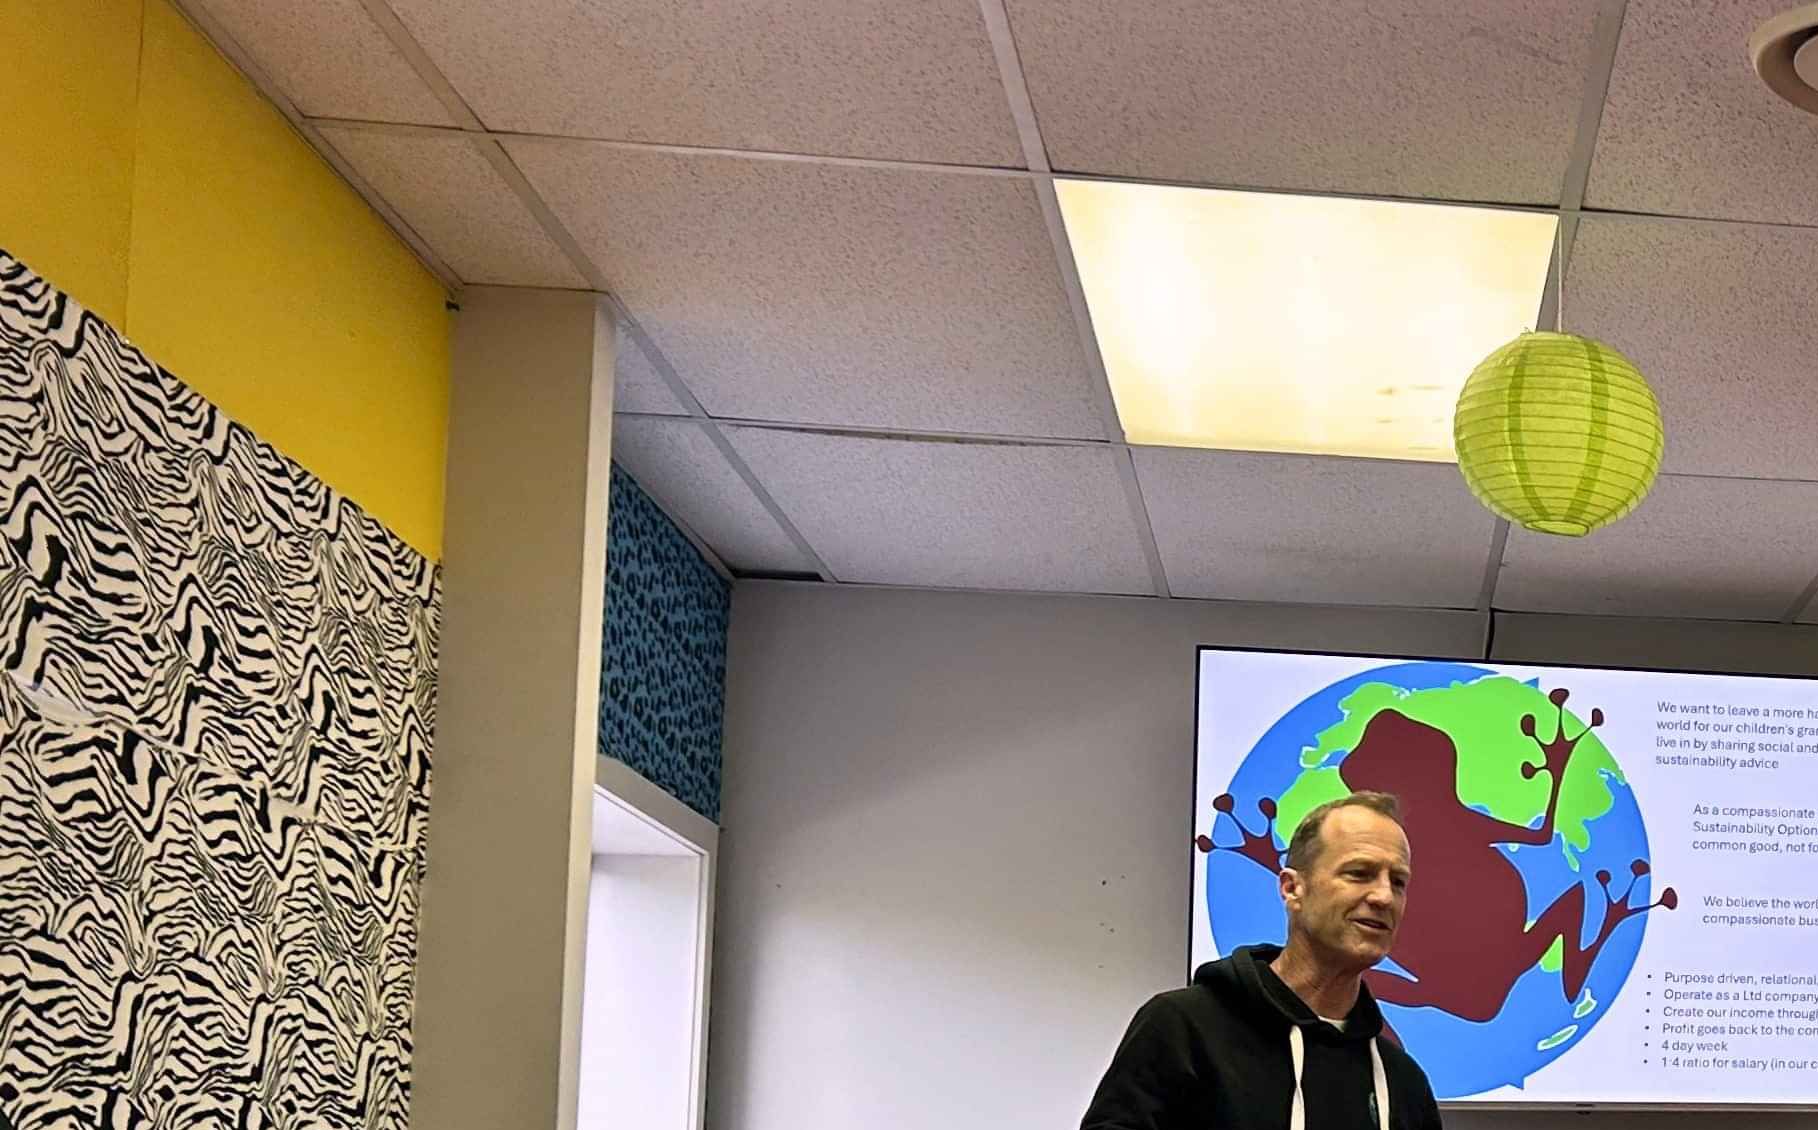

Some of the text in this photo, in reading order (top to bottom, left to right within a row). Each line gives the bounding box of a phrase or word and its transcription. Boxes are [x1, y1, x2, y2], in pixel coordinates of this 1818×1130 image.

[1657, 702, 1677, 714] We
[1680, 704, 1710, 715] want
[1713, 705, 1725, 715] to
[1728, 705, 1759, 717] leave
[1762, 708, 1770, 717] a
[1773, 708, 1804, 719] more
[1656, 720, 1691, 731] world
[1693, 721, 1710, 732] for
[1713, 724, 1733, 733] our
[1656, 737, 1677, 748] live
[1680, 739, 1691, 749] in
[1693, 739, 1708, 752] by
[1710, 740, 1755, 753] sharing
[1759, 742, 1795, 753] social
[1797, 743, 1818, 753] and
[1656, 754, 1779, 769] sustainability advice
[1693, 804, 1709, 815] As
[1712, 806, 1719, 815] a
[1722, 806, 1815, 819] compassionate
[1693, 821, 1775, 836] Sustainability
[1692, 840, 1746, 851] common
[1749, 842, 1783, 854] good,
[1786, 842, 1805, 852] not
[1704, 896, 1723, 907] We
[1726, 897, 1768, 908] believe
[1771, 898, 1791, 909] the
[1703, 914, 1796, 928] compassionate
[1664, 972, 1714, 985] Purpose
[1718, 974, 1758, 986] driven,
[1664, 990, 1713, 1002] Operate
[1716, 992, 1730, 1001] as
[1733, 993, 1740, 1001] a
[1743, 990, 1762, 1001] Ltd
[1663, 1007, 1704, 1017] Create
[1707, 1009, 1726, 1018] our
[1729, 1009, 1774, 1018] income
[1662, 1023, 1695, 1035] Profit
[1697, 1026, 1725, 1038] goes
[1728, 1024, 1758, 1035] back
[1761, 1025, 1773, 1035] to
[1775, 1025, 1795, 1036] the
[1662, 1040, 1727, 1053] 4 day week
[1683, 1058, 1710, 1068] ratio
[1713, 1058, 1728, 1068] for
[1731, 1058, 1768, 1071] salary
[1771, 1058, 1786, 1071] (in
[1789, 1060, 1808, 1069] our
